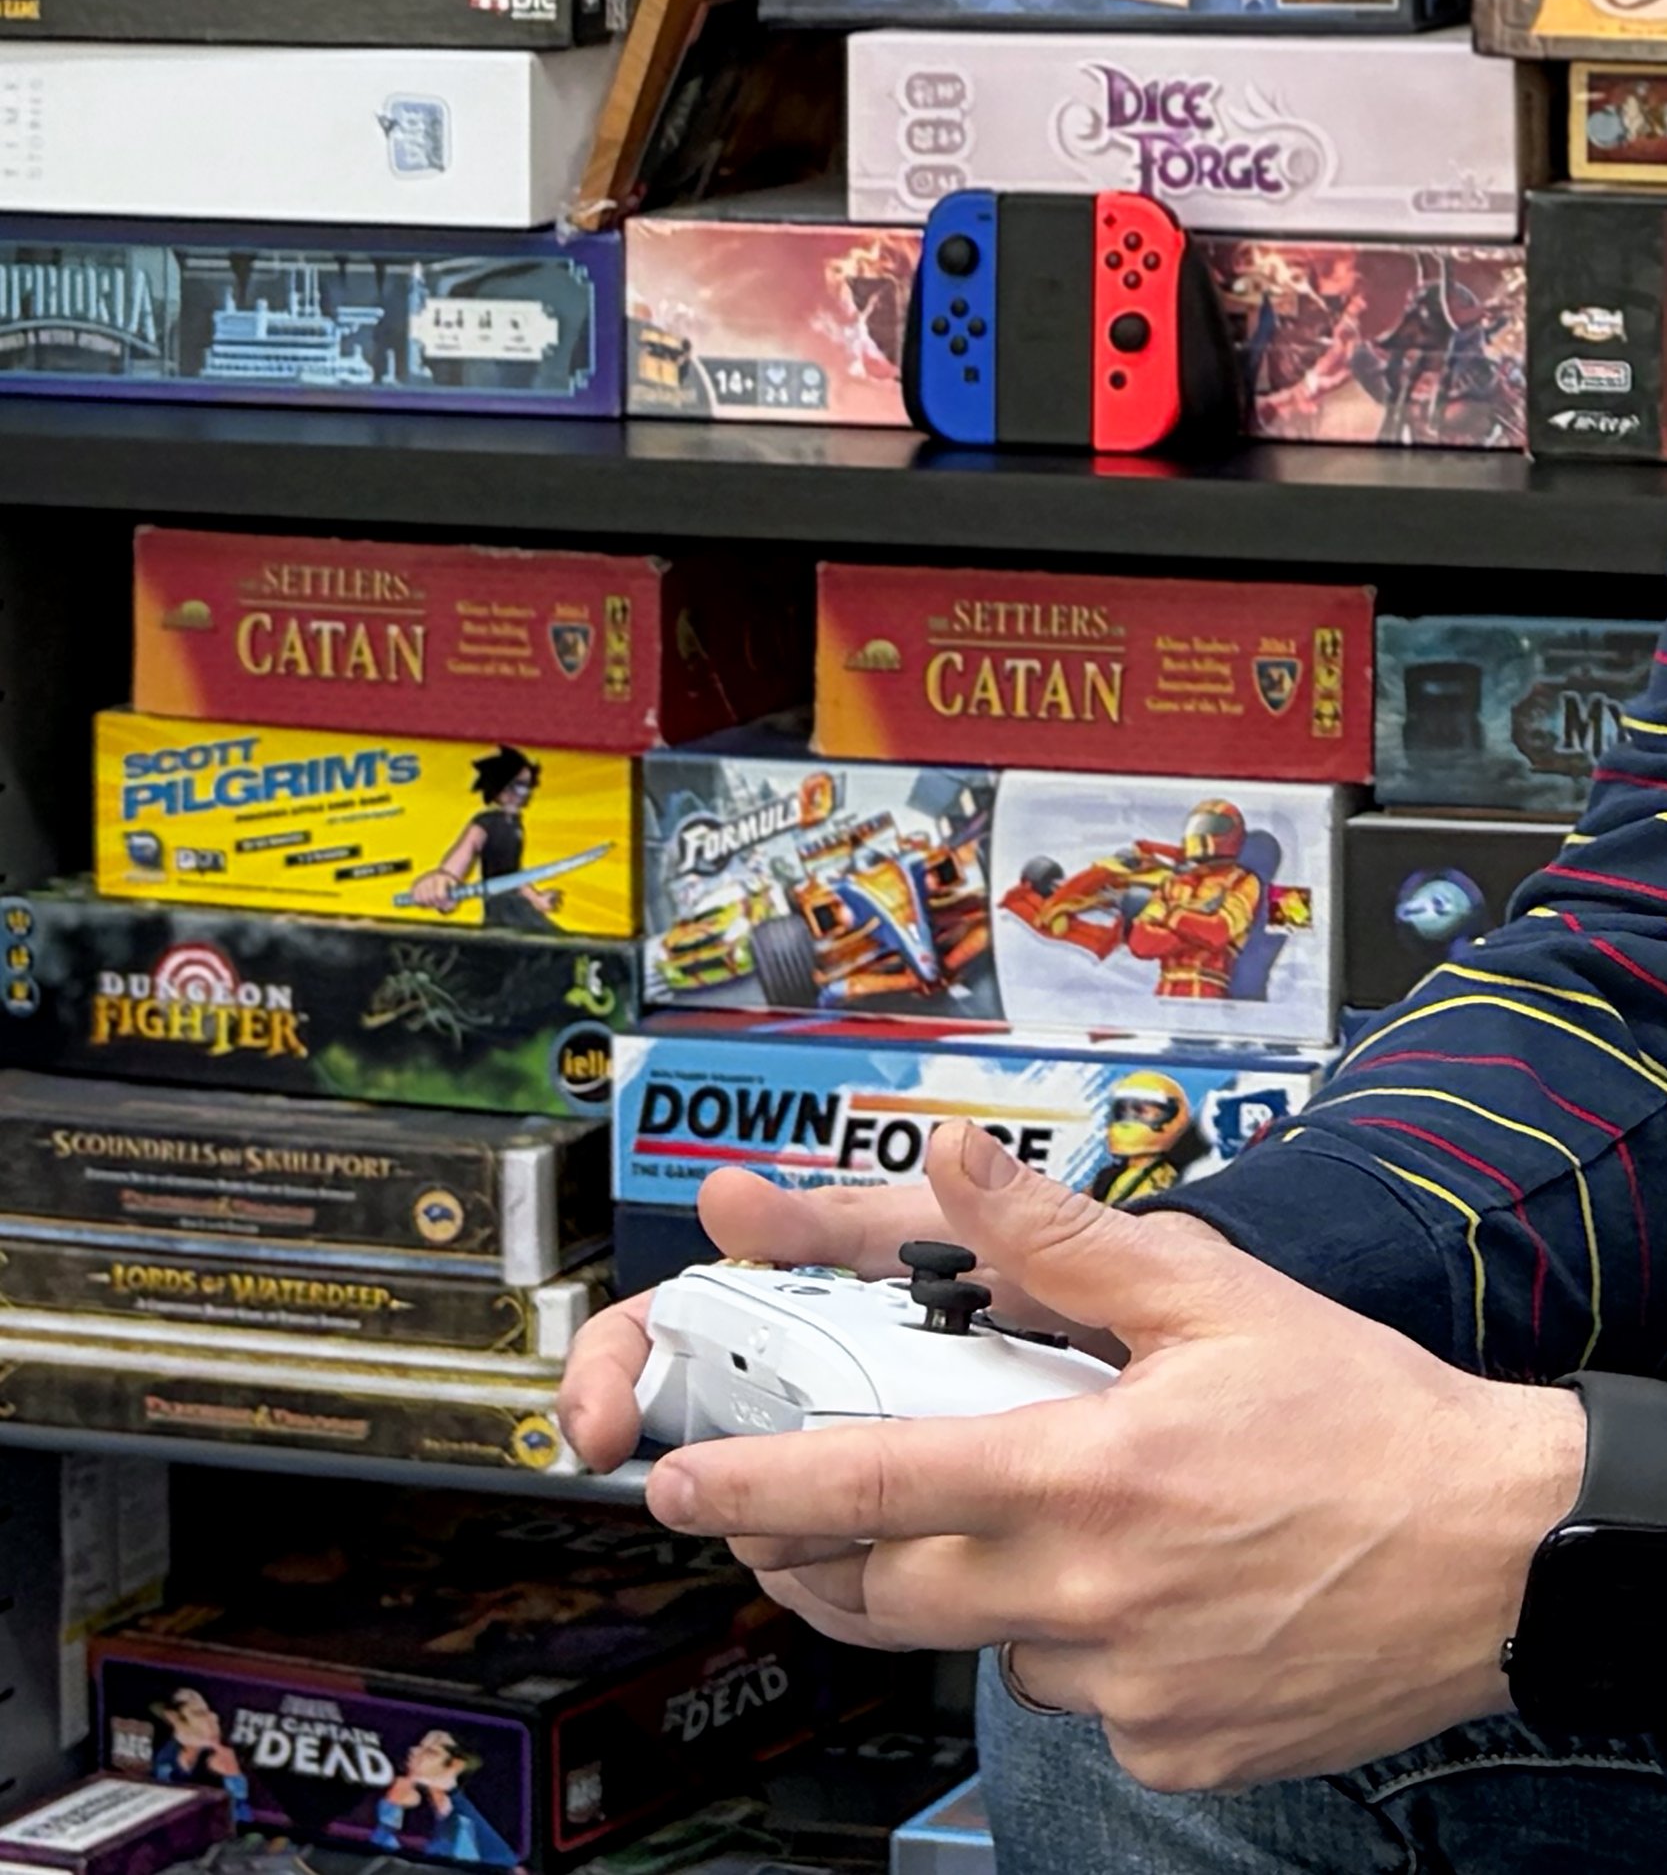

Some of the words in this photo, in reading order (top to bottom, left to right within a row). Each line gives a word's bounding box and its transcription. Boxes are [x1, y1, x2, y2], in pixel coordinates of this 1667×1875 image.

[1082, 63, 1214, 128] DICE
[1117, 129, 1283, 199] FORGE
[715, 363, 755, 394] 14+
[263, 564, 410, 602] SETTLERS
[236, 611, 426, 685] CATAN
[953, 600, 1111, 639] SETTLERS
[925, 651, 1125, 724] CATAN
[122, 747, 422, 820] PILGRIM's
[123, 738, 261, 781] SCOTT
[680, 797, 803, 873] FORMULA
[97, 970, 293, 1010] DUNGEON
[90, 994, 309, 1059] FIGHTER
[638, 1082, 841, 1146] DOWN
[245, 1149, 395, 1180] SKULLPORT
[111, 1262, 197, 1295] LORDS
[228, 1273, 393, 1313] WATERDEEP
[253, 1729, 395, 1787] DEAD
